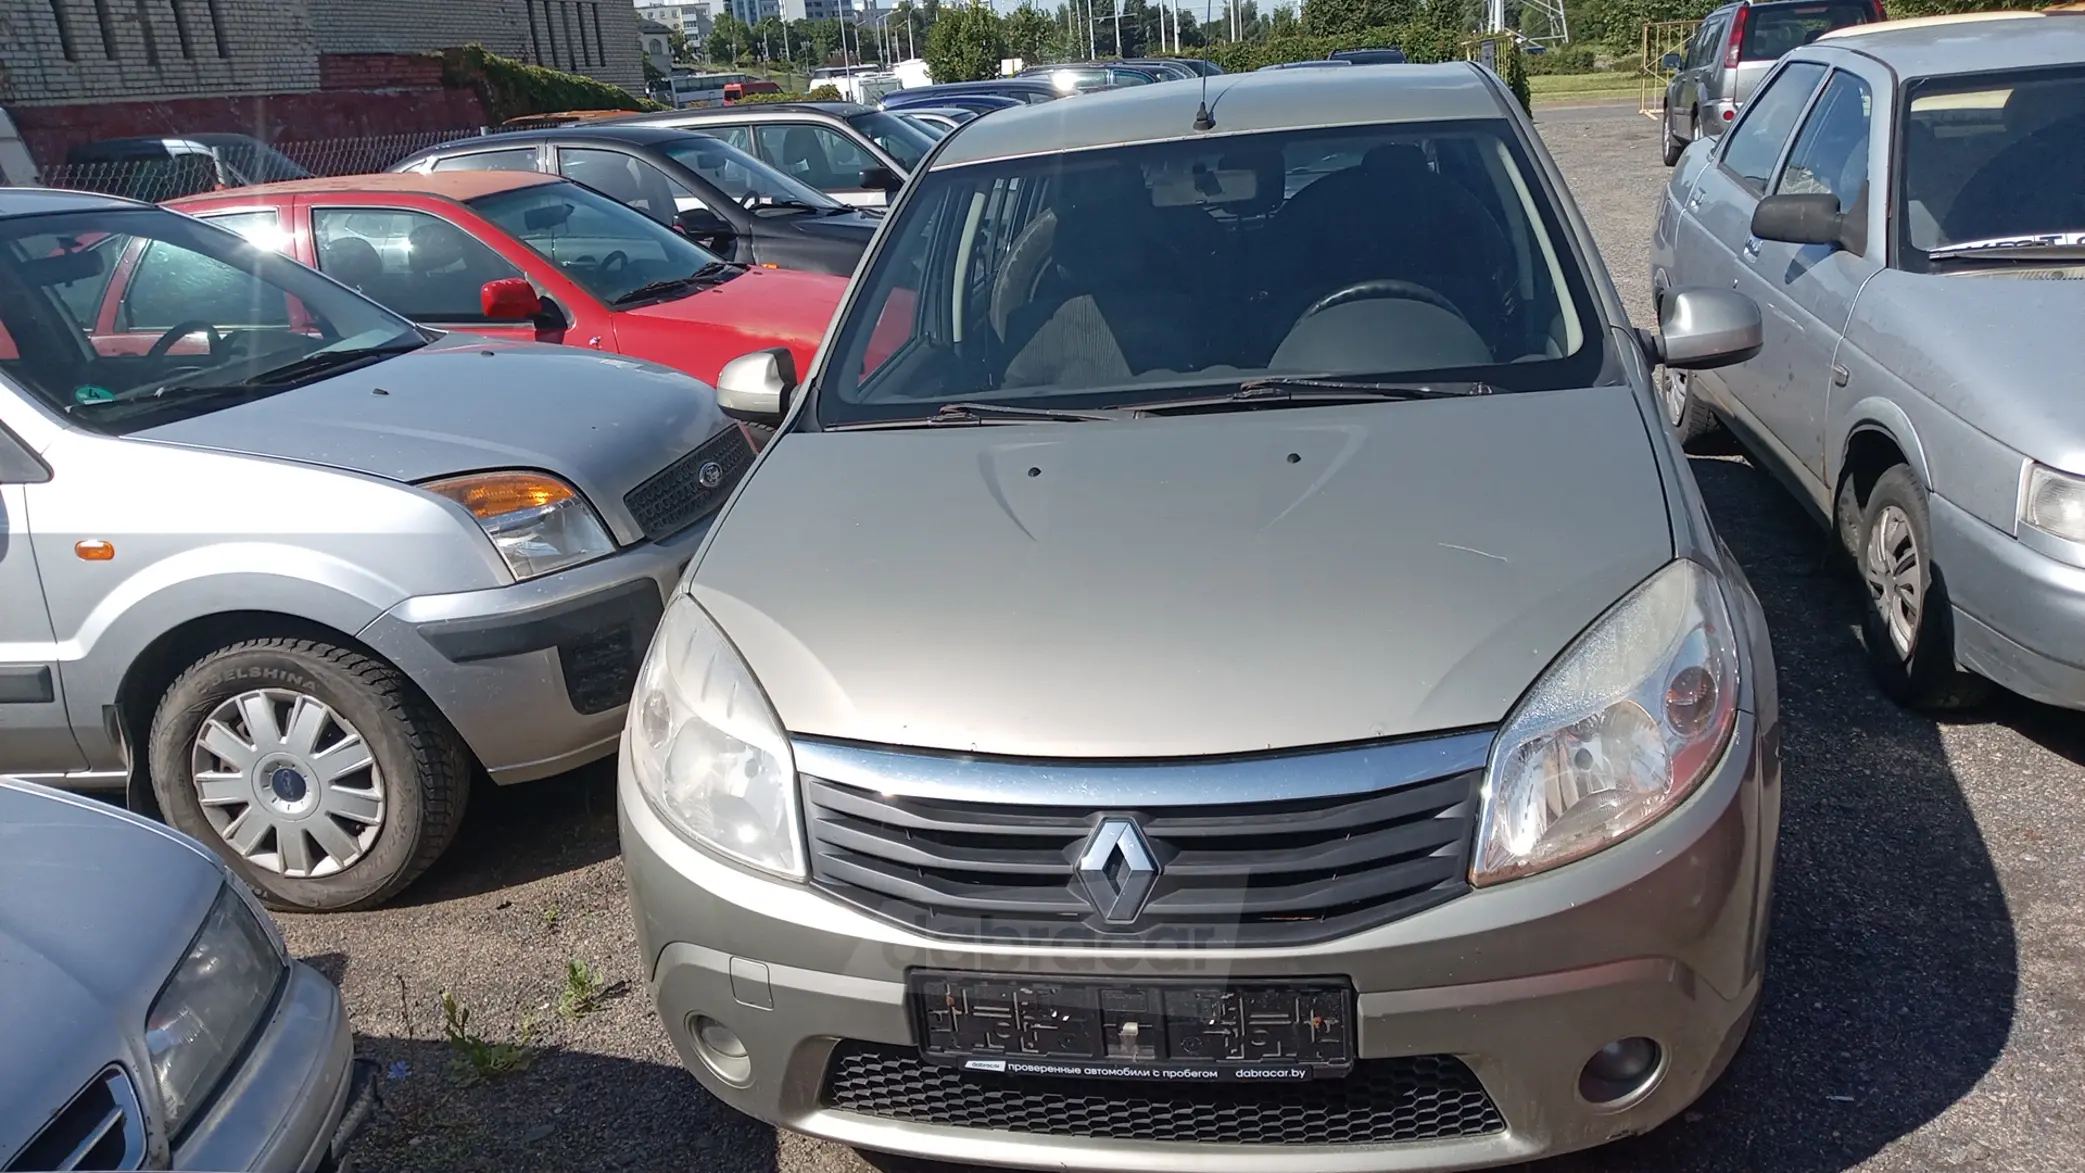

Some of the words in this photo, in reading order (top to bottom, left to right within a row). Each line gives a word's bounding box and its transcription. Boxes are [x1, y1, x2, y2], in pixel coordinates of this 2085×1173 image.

[1007, 1063, 1082, 1075] проверенные
[1084, 1066, 1151, 1077] автомобили
[1152, 1069, 1160, 1077] с
[1162, 1068, 1218, 1079] пробегом
[1235, 1068, 1306, 1079] dabracar.by
